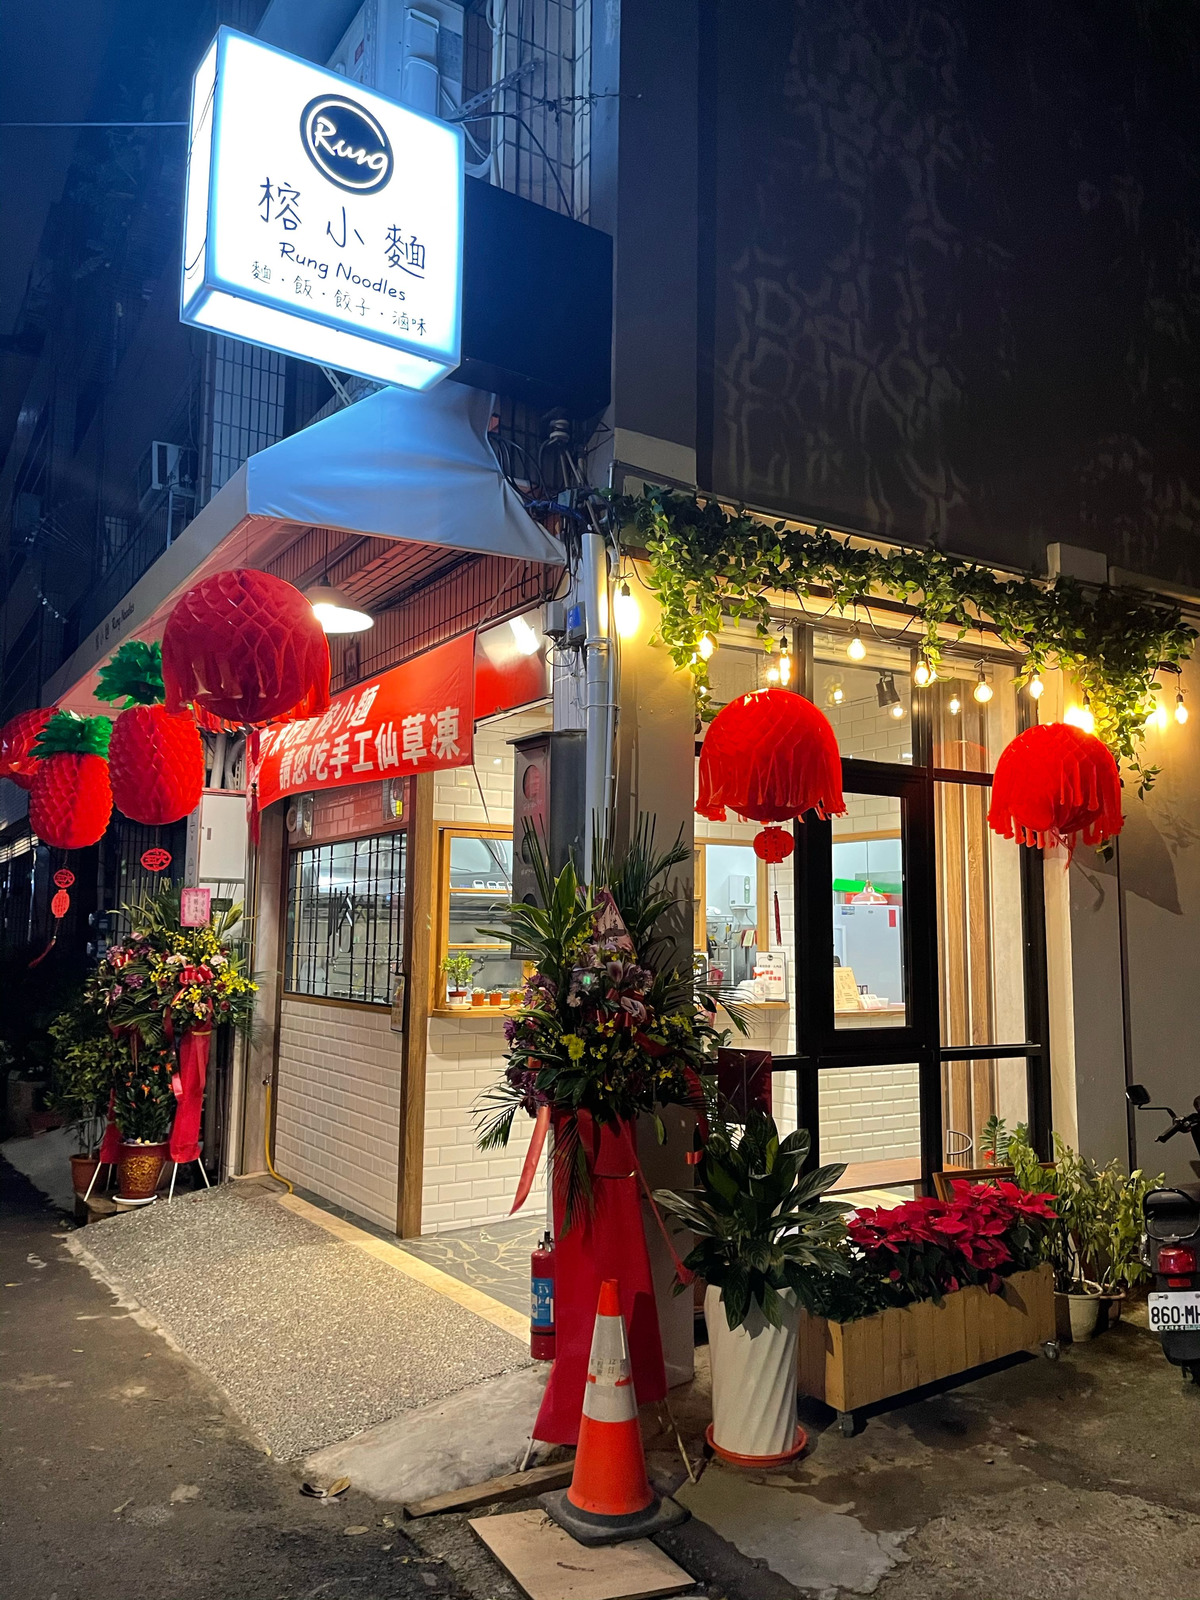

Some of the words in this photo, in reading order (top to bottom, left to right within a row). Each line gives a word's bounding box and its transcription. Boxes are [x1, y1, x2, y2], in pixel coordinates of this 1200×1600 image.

[313, 115, 389, 172] Rung
[257, 176, 426, 279] 榕小麵
[278, 241, 329, 280] Rung
[335, 262, 406, 301] Noodles
[279, 705, 462, 792] 請您吃手工仙草凍
